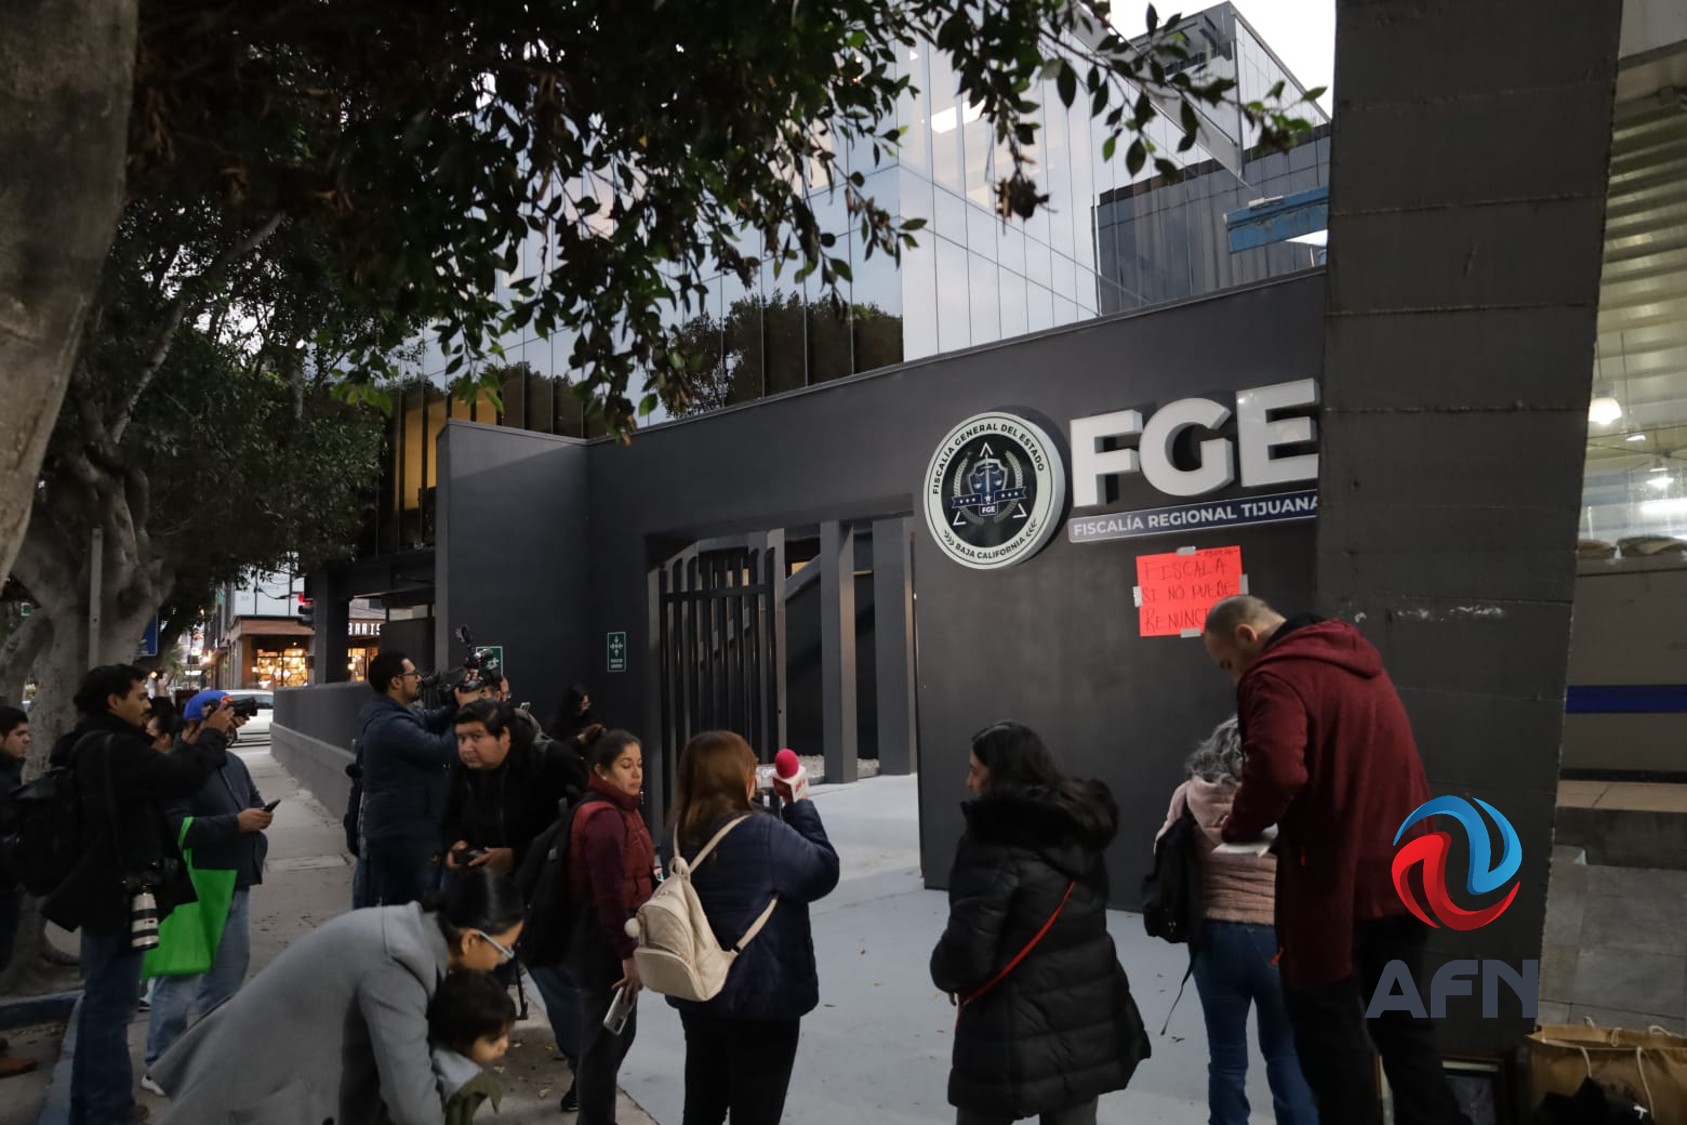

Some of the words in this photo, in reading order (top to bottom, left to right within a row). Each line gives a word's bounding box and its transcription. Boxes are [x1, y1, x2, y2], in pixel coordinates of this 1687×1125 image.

[1070, 378, 1321, 508] FGE
[932, 446, 955, 495] FISCALÍA
[954, 423, 999, 446] GENERAL
[1000, 423, 1018, 437] DEL
[1019, 433, 1045, 472] ESTADO
[981, 505, 996, 513] FGE
[1074, 515, 1144, 537] FISCALÍA
[1148, 505, 1237, 529] REGIONAL
[954, 543, 976, 558] BAJA
[976, 536, 1025, 560] CALIFORNIA
[1142, 587, 1157, 603] SI
[1168, 585, 1185, 600] NO
